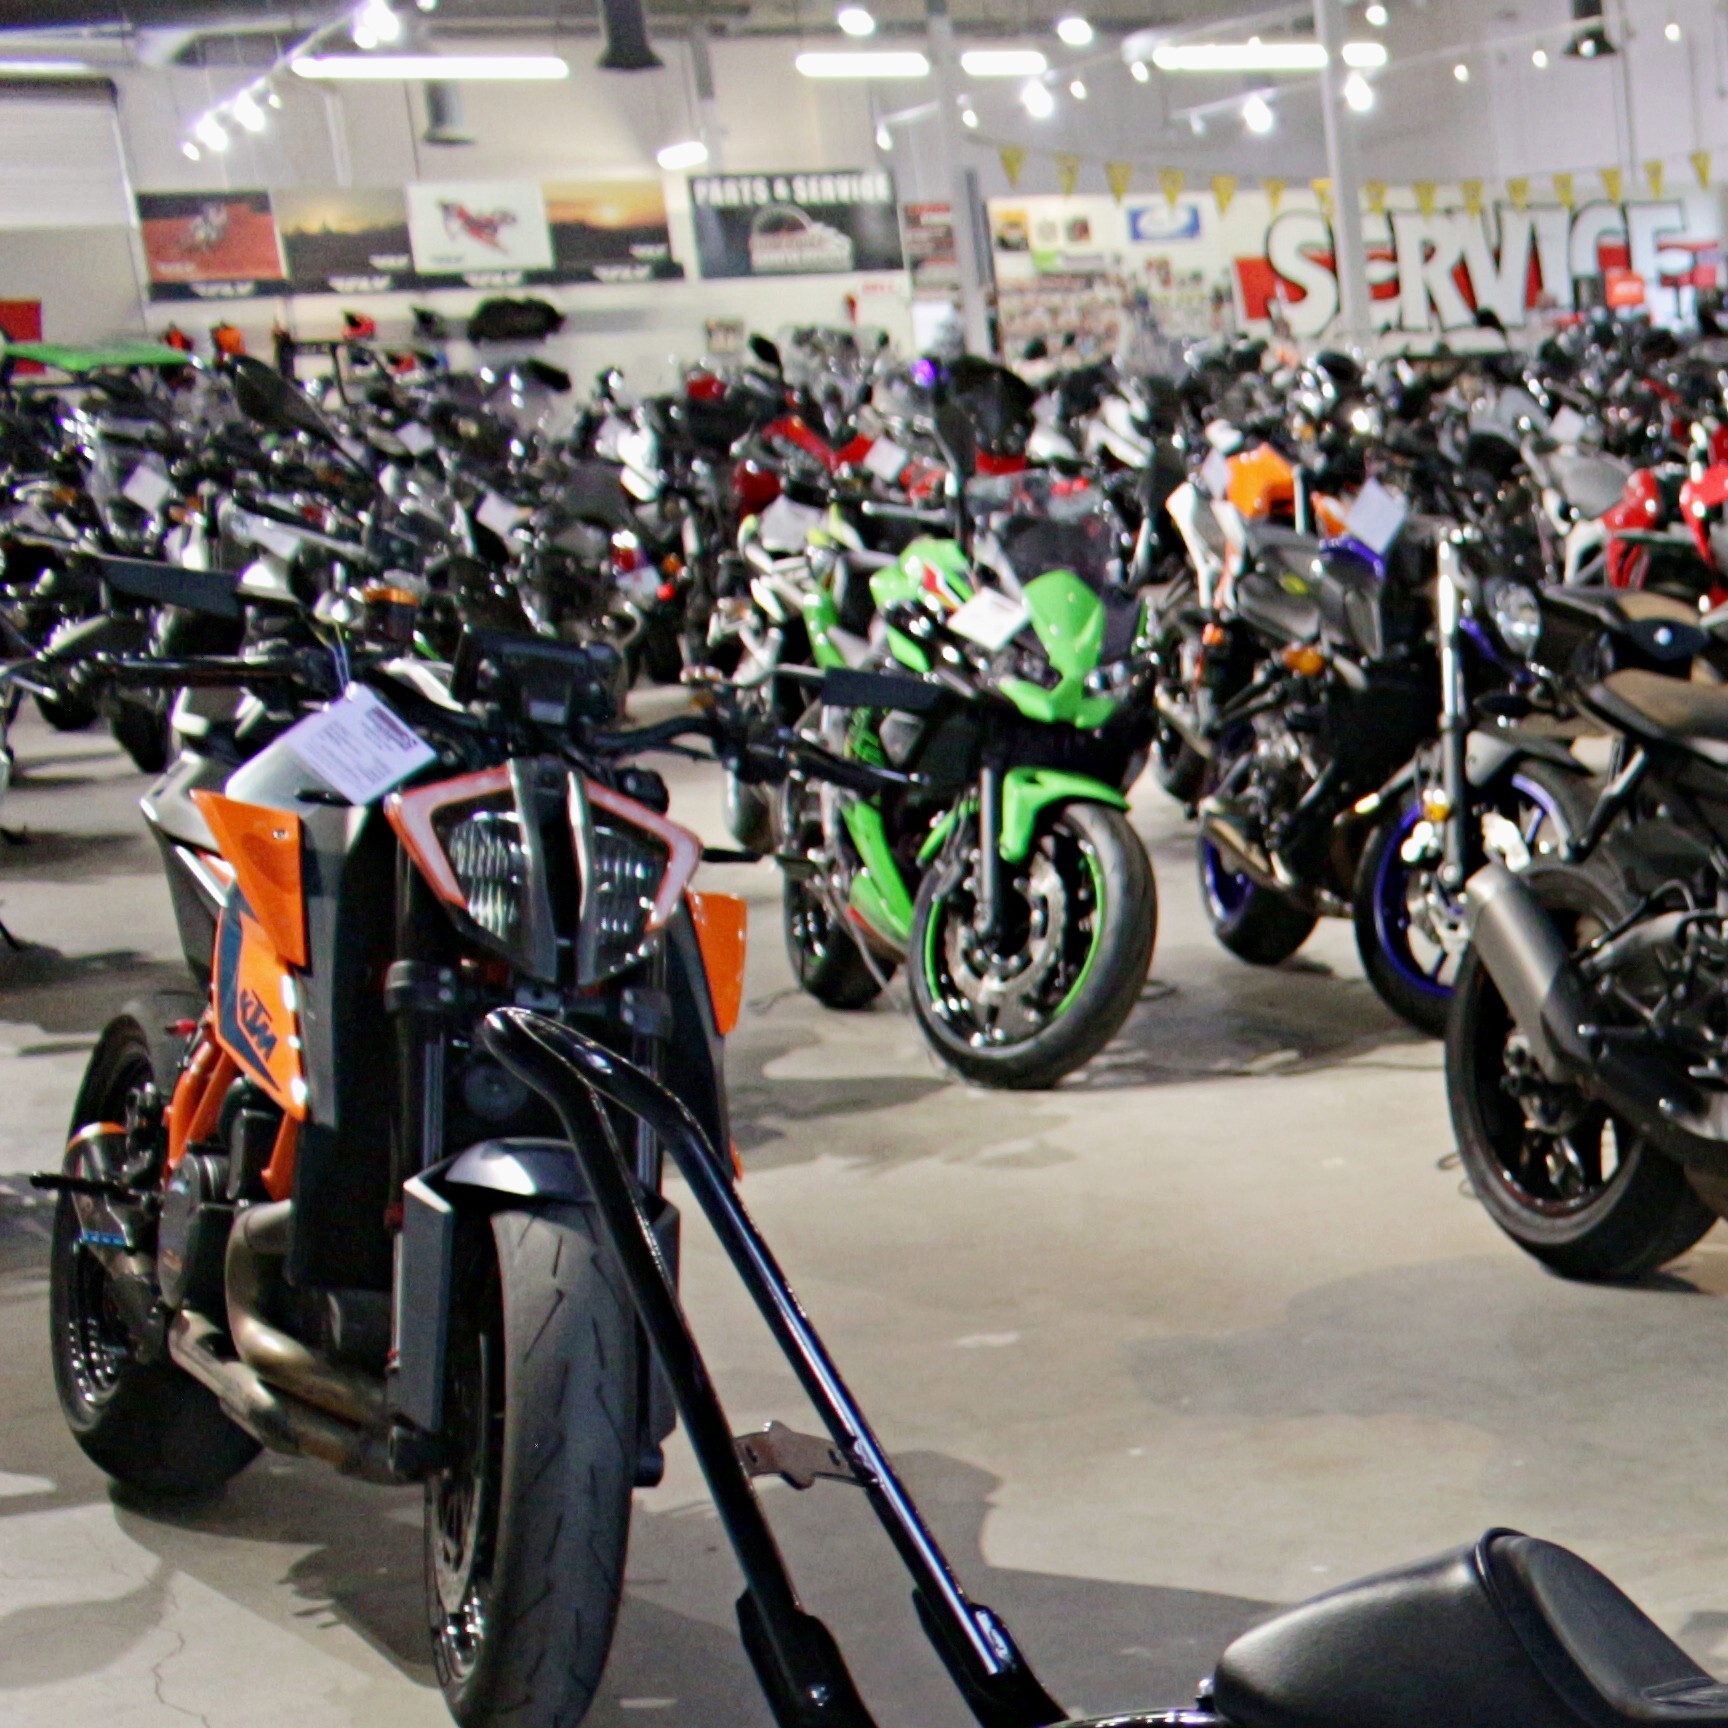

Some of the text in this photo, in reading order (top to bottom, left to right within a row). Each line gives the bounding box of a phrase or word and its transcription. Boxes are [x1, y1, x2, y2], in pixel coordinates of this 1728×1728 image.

[693, 175, 770, 207] PARTS
[791, 170, 891, 205] SERVICE
[1267, 198, 1687, 338] SERVICE
[239, 988, 279, 1063] KTM
